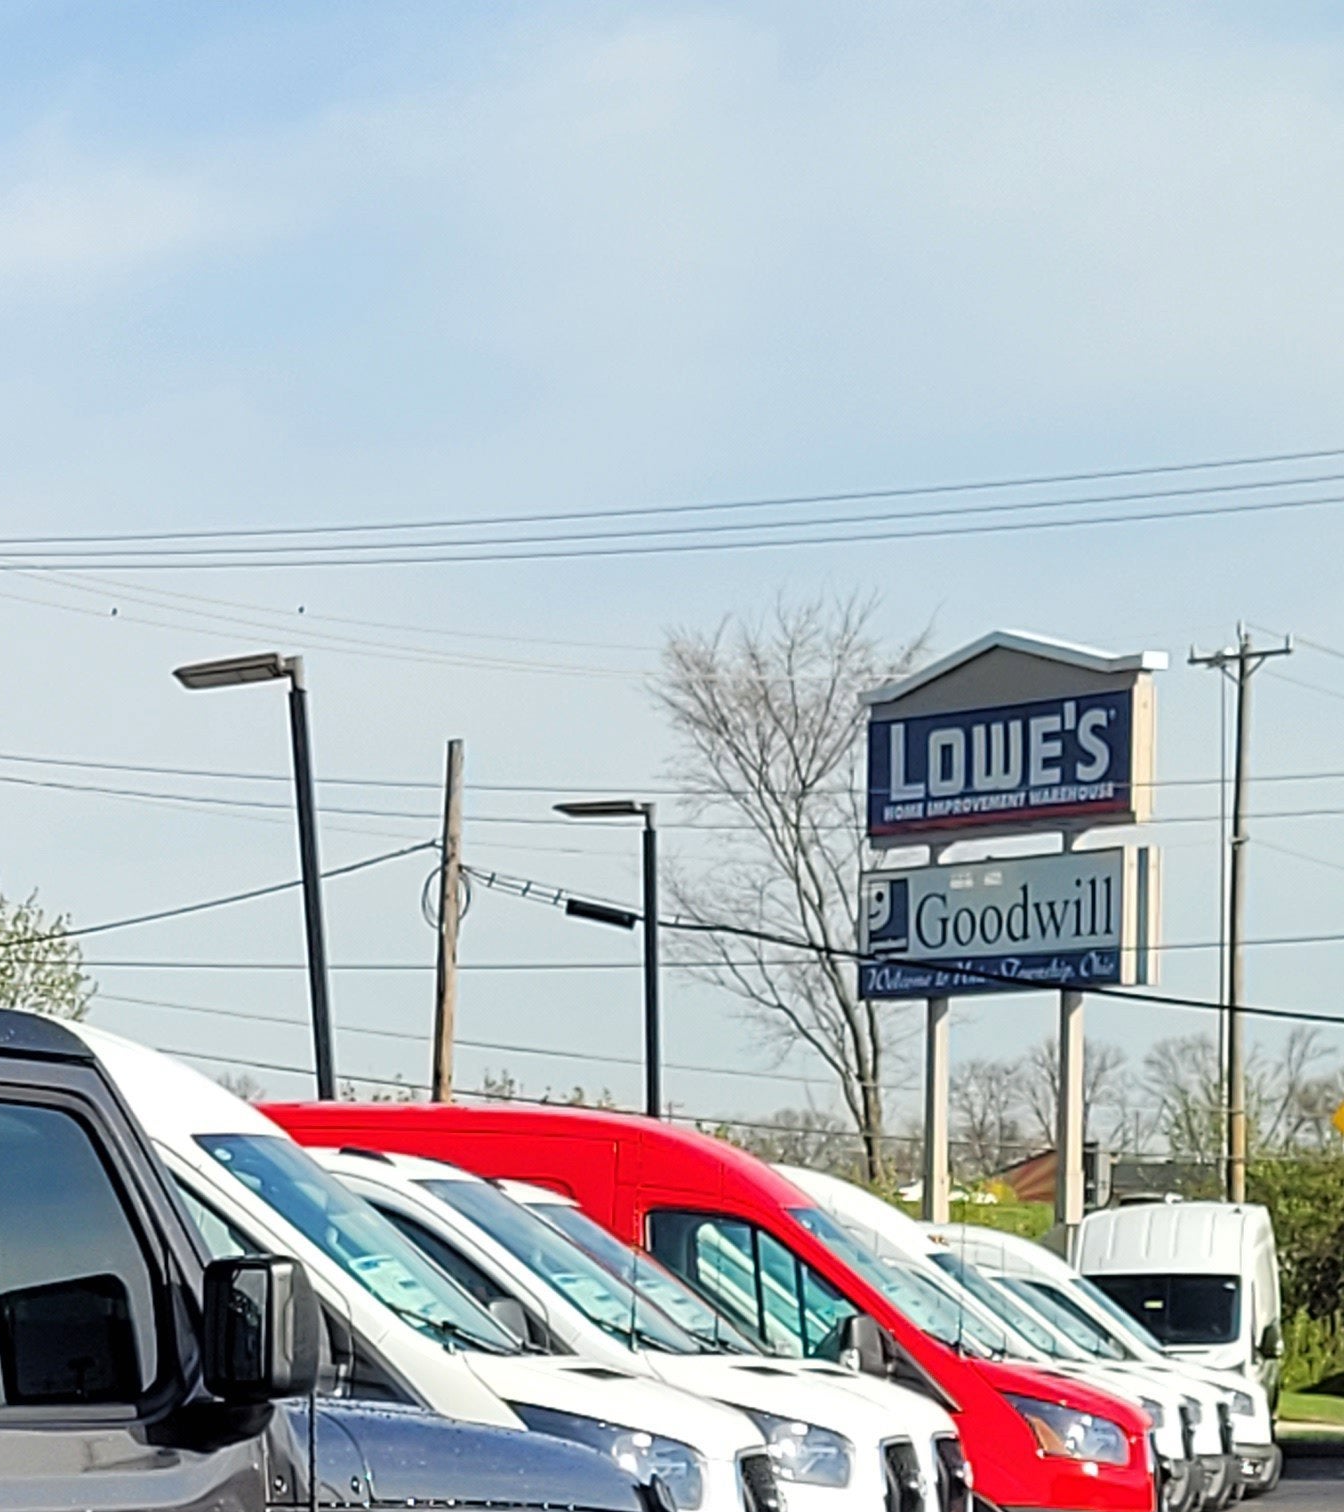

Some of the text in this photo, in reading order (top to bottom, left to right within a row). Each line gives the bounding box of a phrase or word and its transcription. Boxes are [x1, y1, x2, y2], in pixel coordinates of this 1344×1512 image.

[890, 700, 1110, 801] LOWE'S
[883, 782, 1115, 822] HOME IMPROVEMENT WAREHOUSE
[915, 876, 1112, 950] Goodwill
